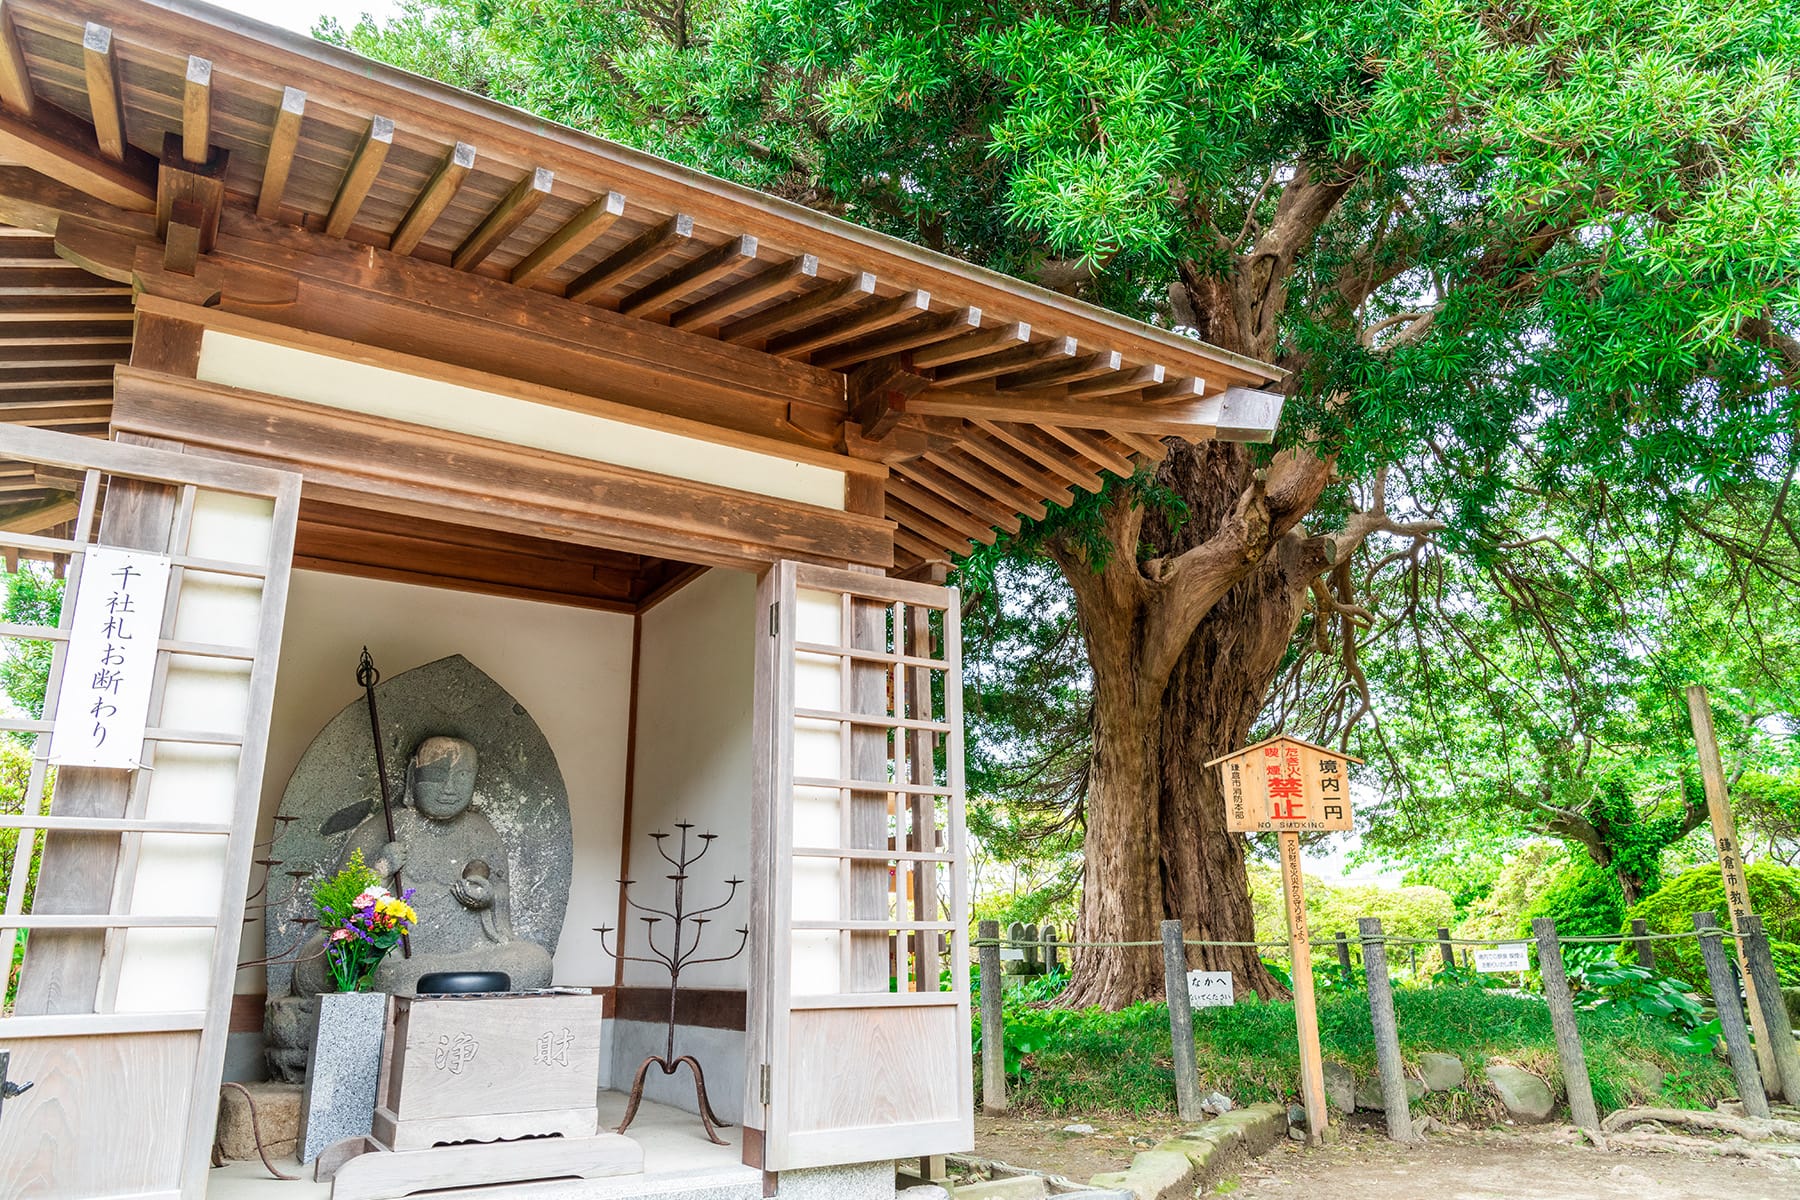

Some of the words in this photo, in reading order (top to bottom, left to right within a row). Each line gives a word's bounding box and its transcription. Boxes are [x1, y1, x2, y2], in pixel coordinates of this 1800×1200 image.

[90, 565, 141, 748] 千社札お断わり
[1264, 747, 1281, 776] 喫煙
[1285, 747, 1301, 776] たき火
[1231, 763, 1244, 820] 鎌倉市消防本部
[1267, 777, 1307, 820] 禁止
[1319, 759, 1343, 820] 境内一円
[1279, 821, 1325, 829] SMOKING
[1192, 977, 1227, 987] なかへ
